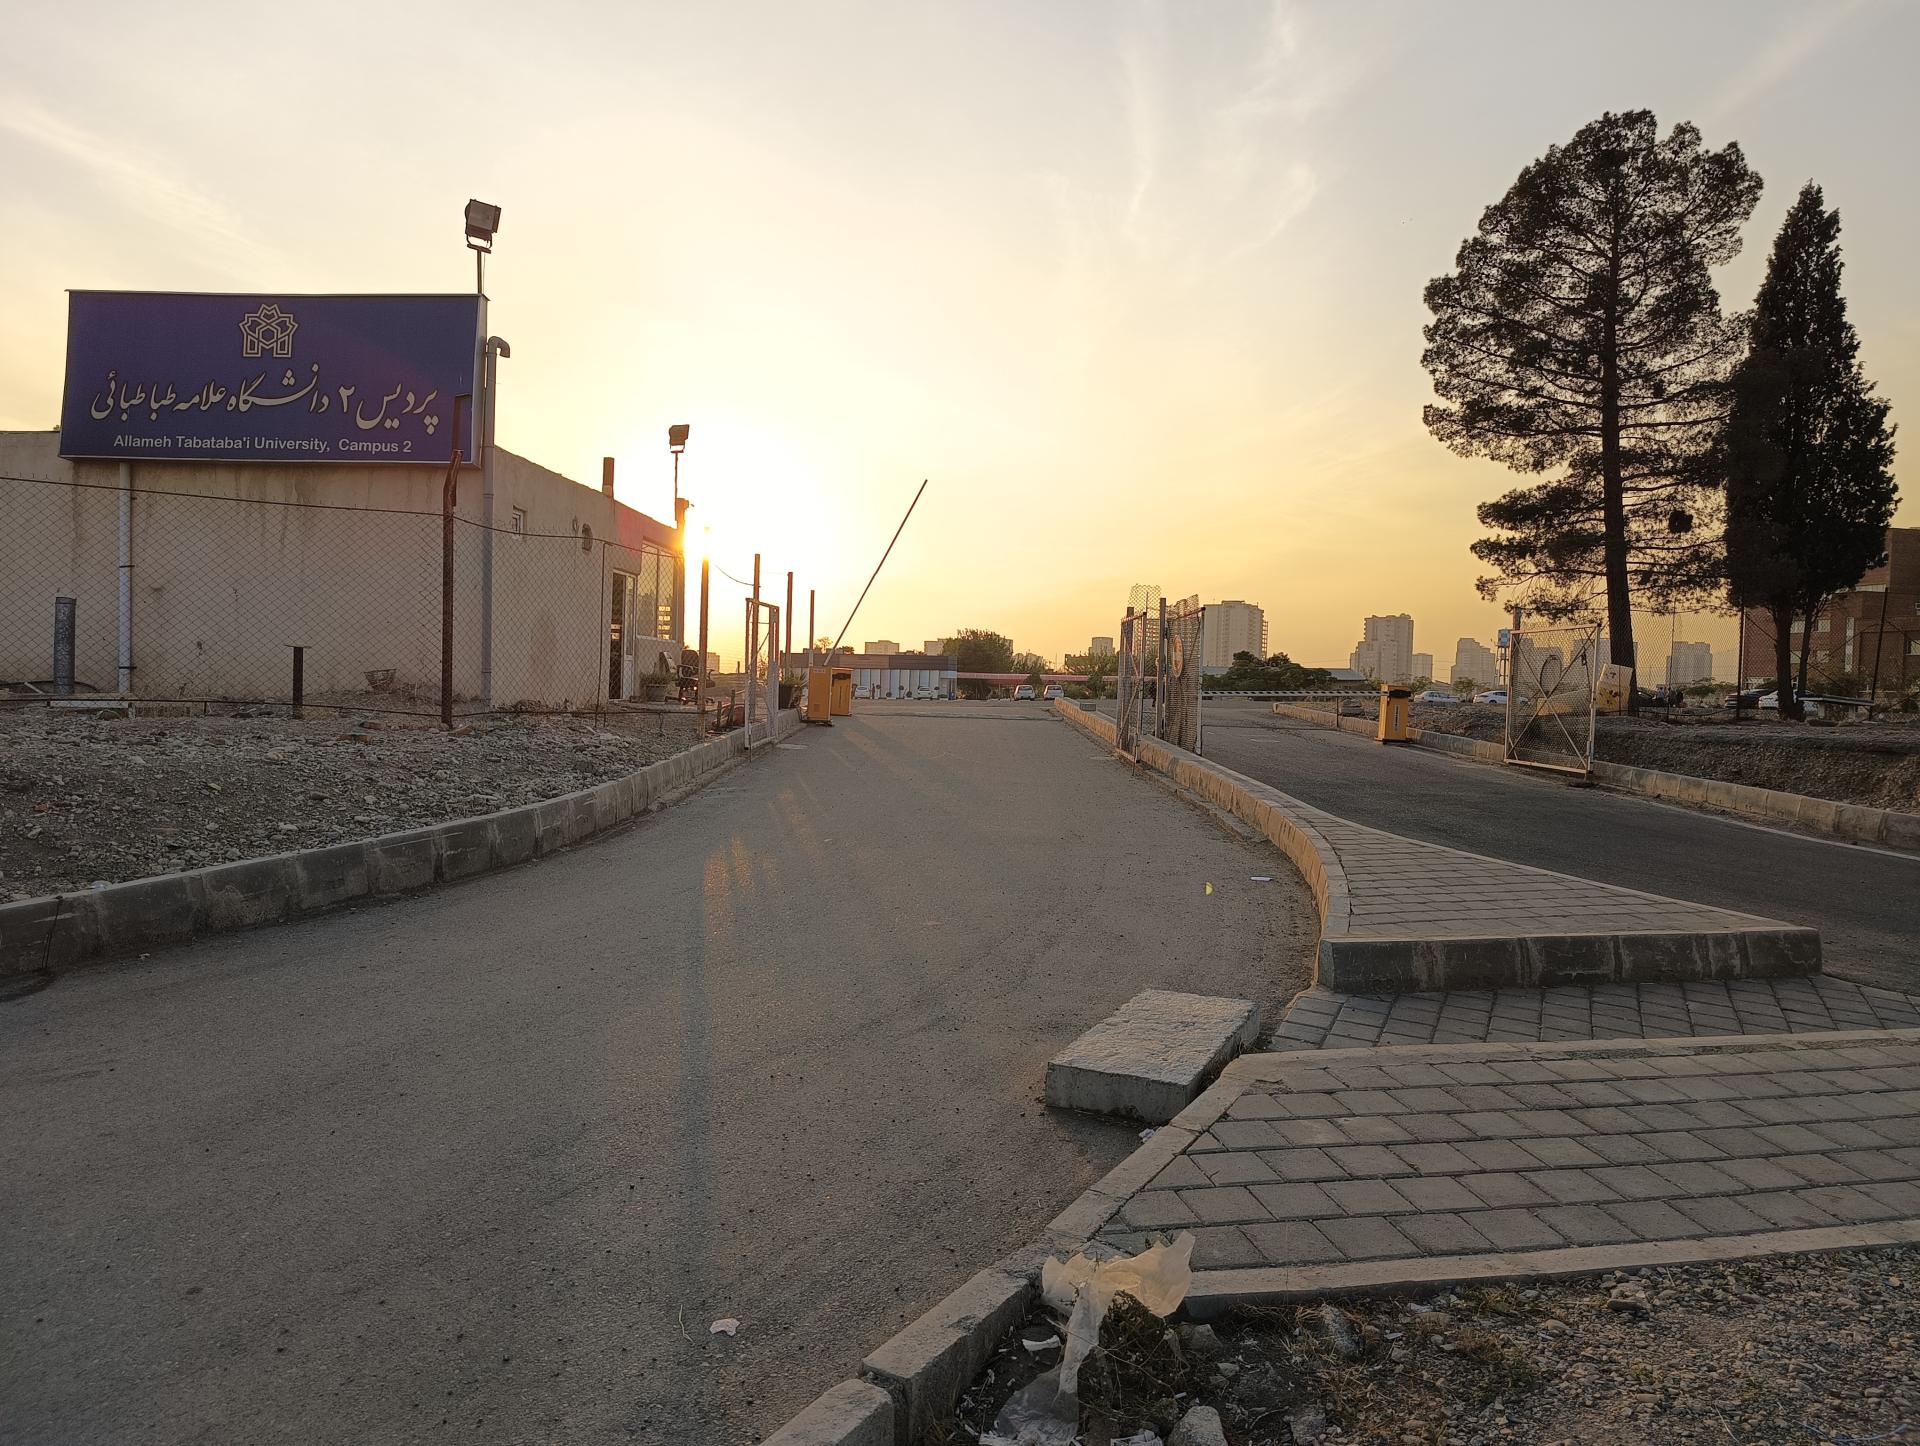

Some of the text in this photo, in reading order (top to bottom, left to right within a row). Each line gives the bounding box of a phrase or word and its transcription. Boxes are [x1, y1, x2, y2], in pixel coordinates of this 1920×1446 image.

[173, 381, 227, 411] علامه
[227, 363, 330, 413] دانشگاه
[339, 385, 356, 413] ۲
[356, 383, 439, 435] پردیس
[113, 435, 412, 454] Allameh Tabataba'i University, Campus 2
